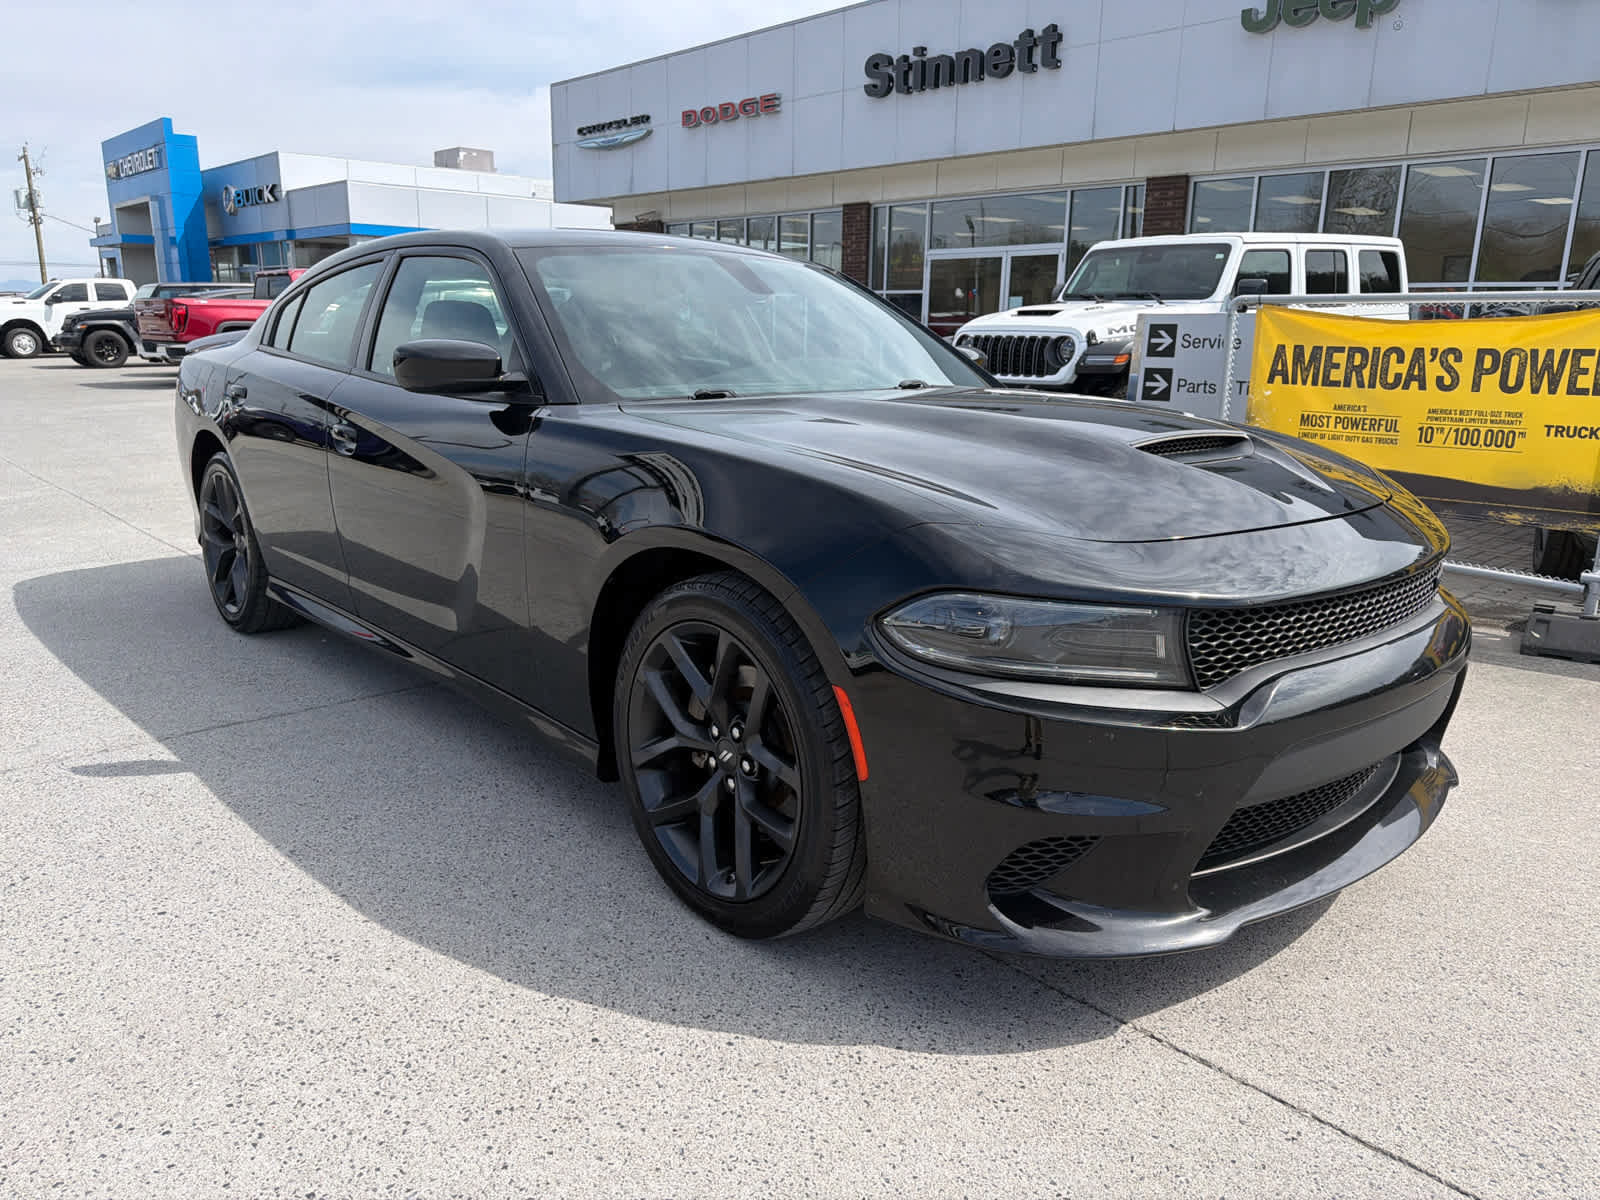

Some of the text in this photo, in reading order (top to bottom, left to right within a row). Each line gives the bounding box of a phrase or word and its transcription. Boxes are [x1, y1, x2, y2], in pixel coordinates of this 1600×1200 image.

[864, 23, 1063, 98] Stinnett
[681, 93, 781, 129] DODGE
[118, 148, 158, 178] CHEVROLET
[233, 183, 278, 208] BUICK
[1267, 343, 1600, 397] AMERICA'S POWE
[1177, 378, 1217, 394] Parts
[1333, 403, 1368, 413] AMERICA'S
[1427, 408, 1458, 416] AMERICA'S
[1459, 409, 1473, 417] BEST
[1504, 411, 1524, 419] TRUCK
[1300, 413, 1400, 433] MOST POWERFUL
[1426, 415, 1522, 426] POWERTRAIN LIMITED WARRANTY
[1328, 433, 1344, 441] LIGHT
[1361, 436, 1373, 444] GAS
[1375, 437, 1398, 445] TRUCKS
